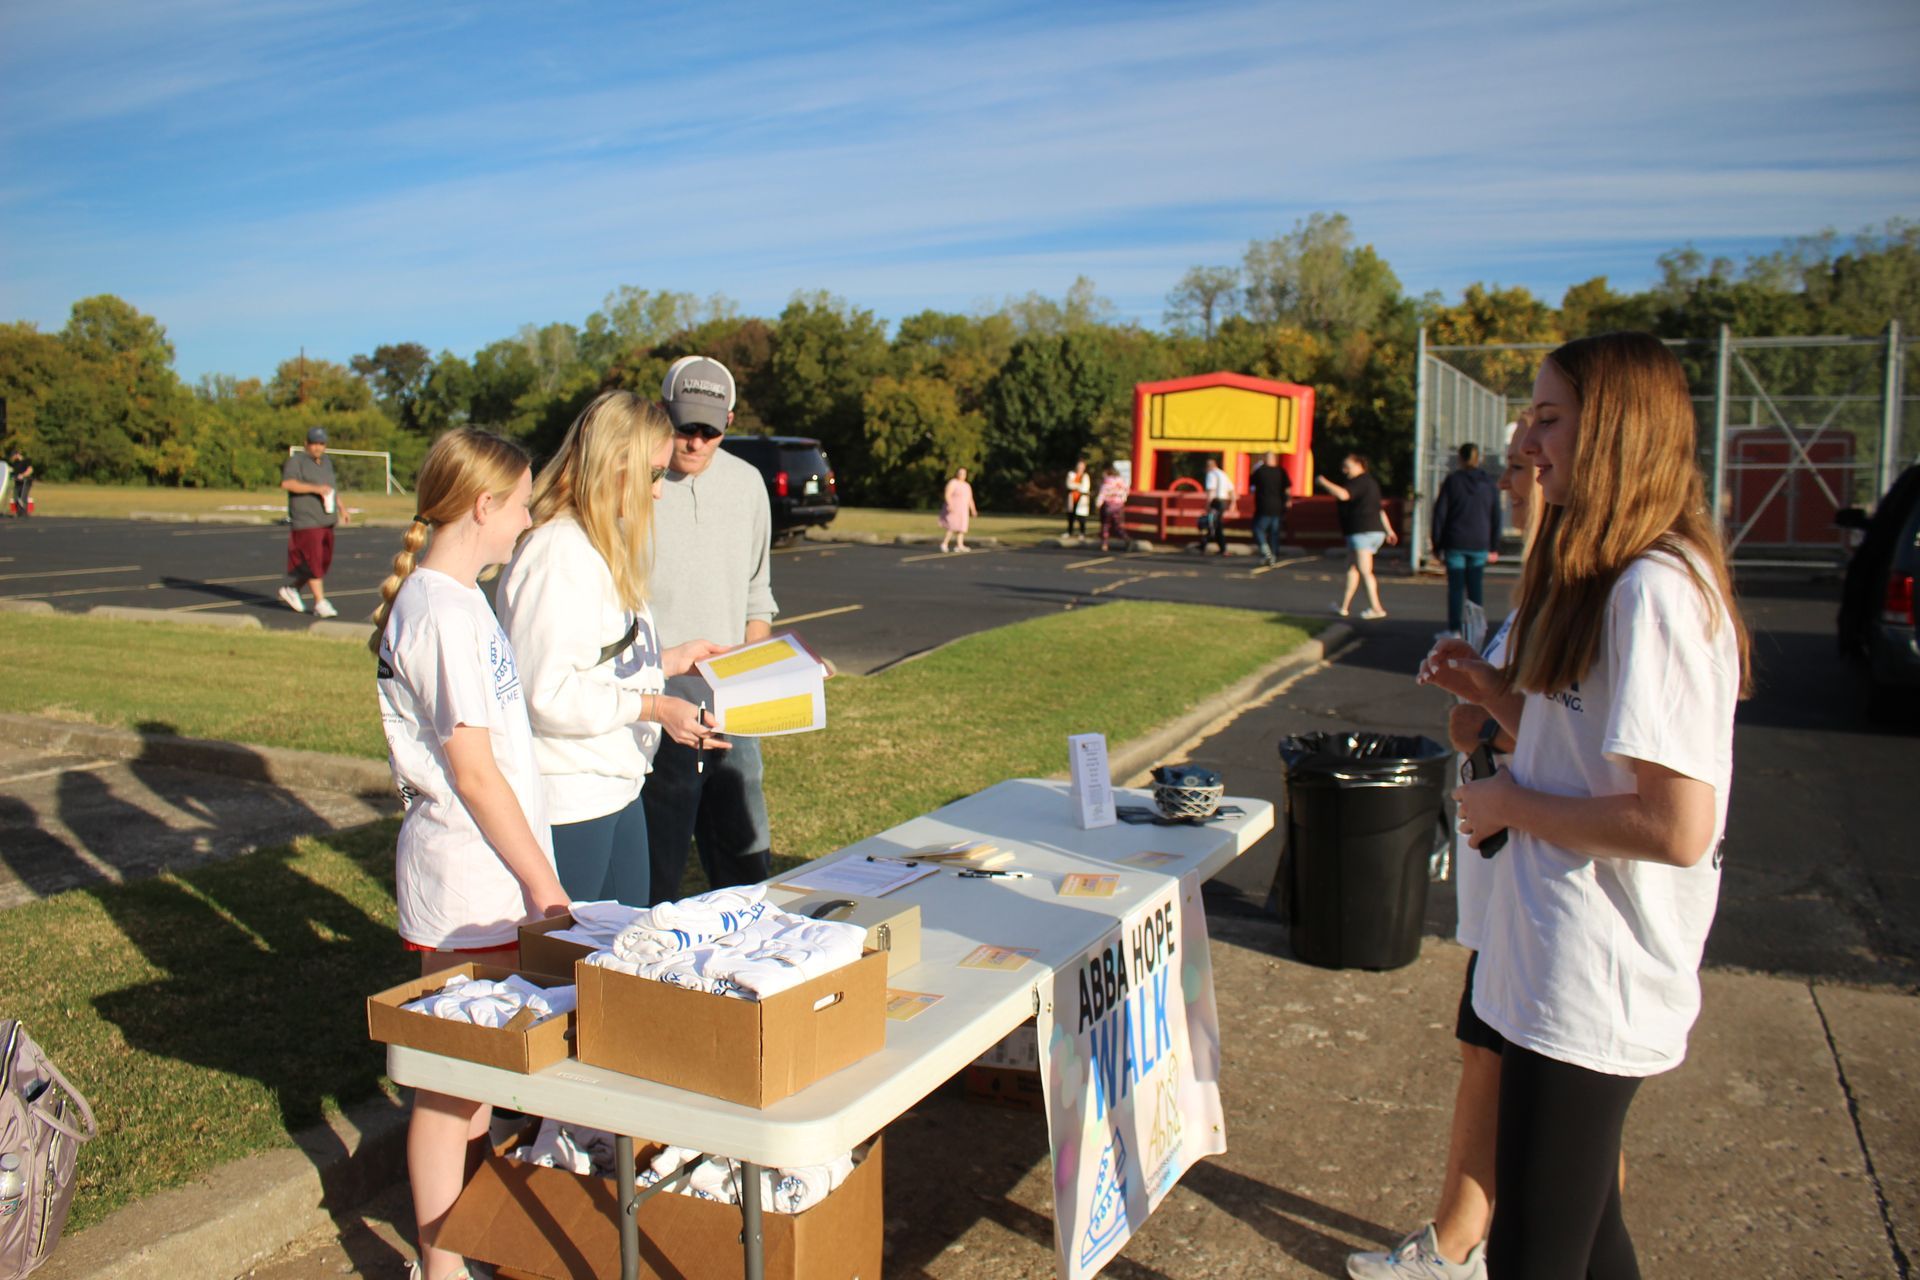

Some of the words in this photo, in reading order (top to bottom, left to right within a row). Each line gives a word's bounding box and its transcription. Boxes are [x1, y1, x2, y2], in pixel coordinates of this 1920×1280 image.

[681, 388, 725, 400] ARMOUR
[1078, 938, 1130, 1035] ABBA
[1131, 901, 1175, 986] HOPE
[1090, 963, 1171, 1122] WALK
